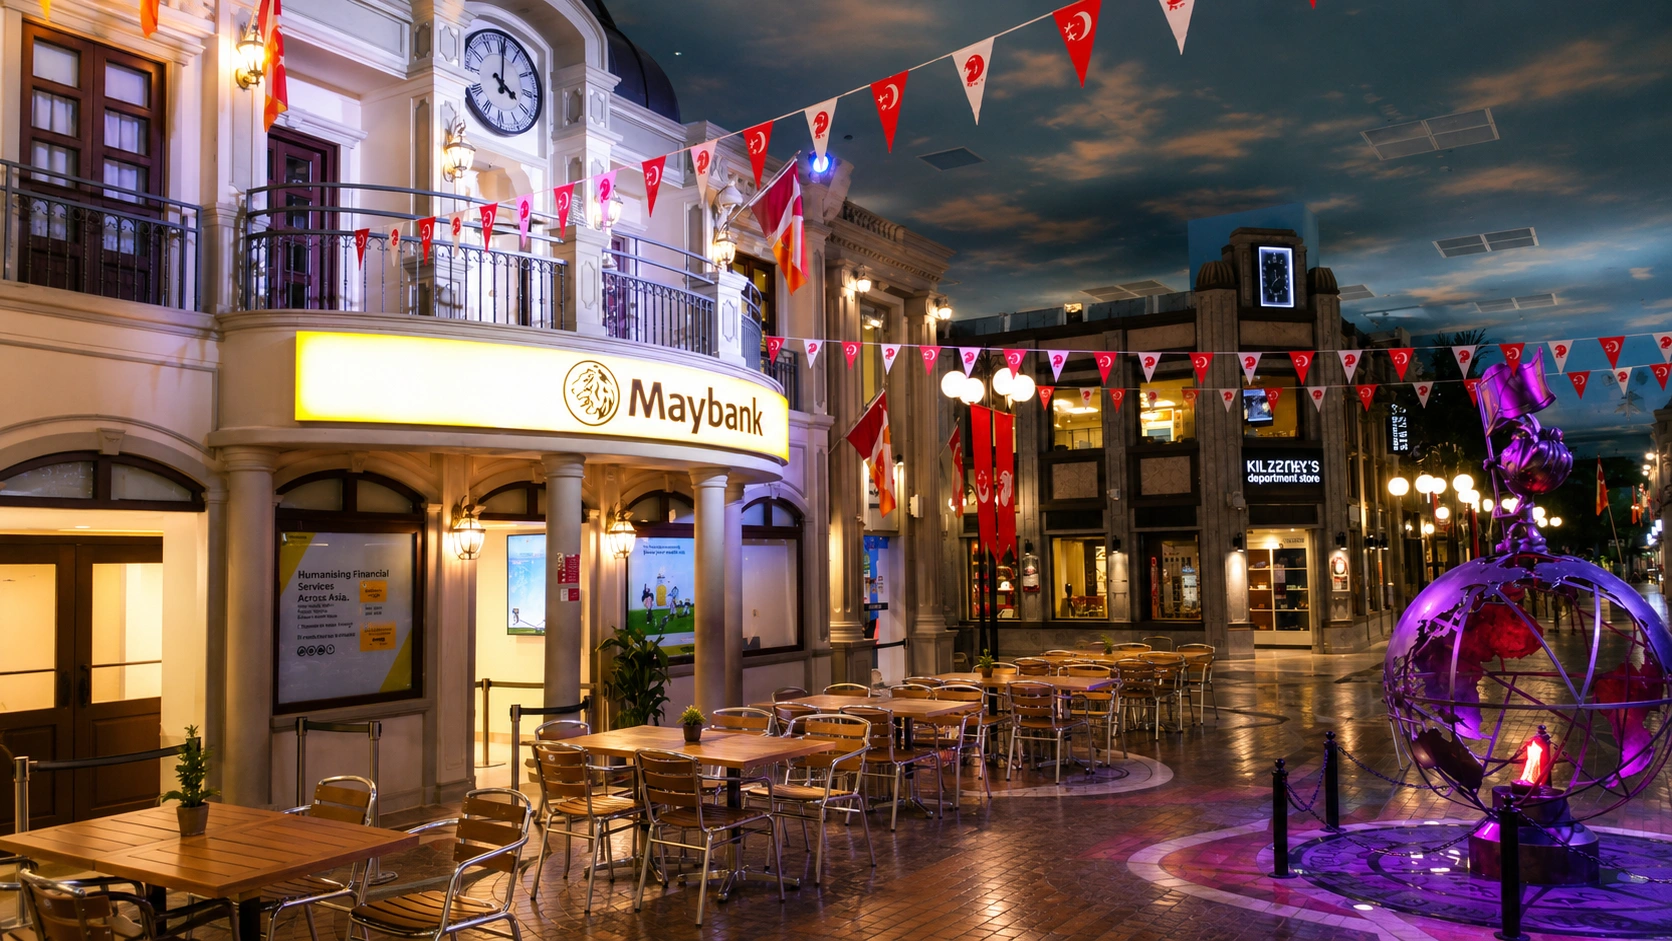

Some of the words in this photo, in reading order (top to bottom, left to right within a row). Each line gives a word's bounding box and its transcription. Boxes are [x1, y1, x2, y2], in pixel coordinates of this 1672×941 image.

[628, 378, 763, 436] Maybank
[1247, 474, 1298, 485] department
[1299, 474, 1321, 483] store
[297, 570, 352, 579] Humanising
[353, 569, 390, 578] Financial
[297, 582, 335, 591] Services
[297, 594, 327, 602] Across
[328, 593, 350, 602] Asia.
